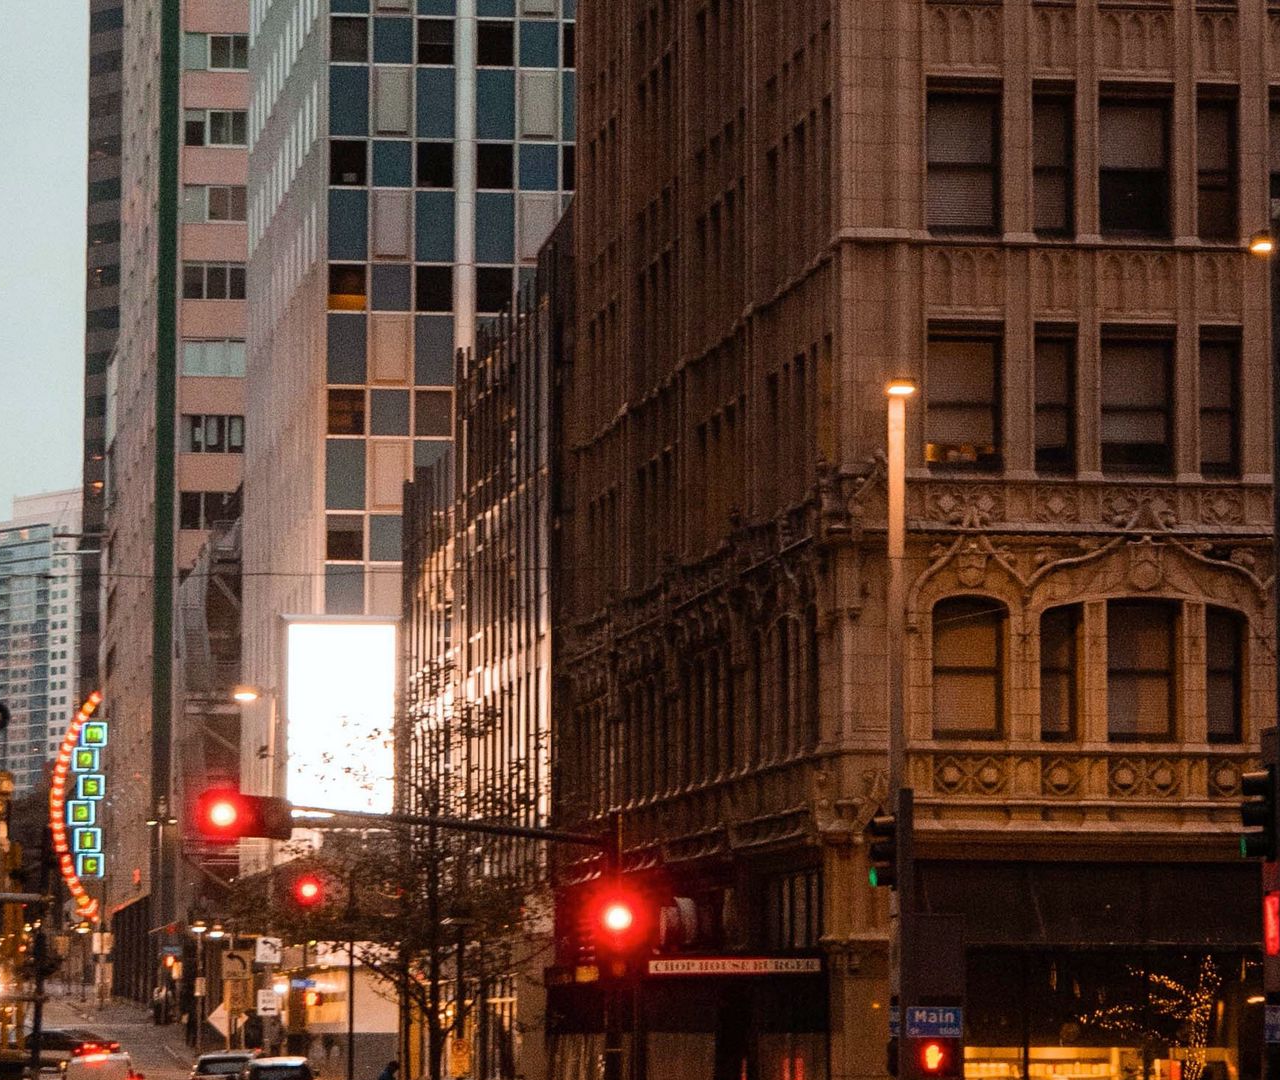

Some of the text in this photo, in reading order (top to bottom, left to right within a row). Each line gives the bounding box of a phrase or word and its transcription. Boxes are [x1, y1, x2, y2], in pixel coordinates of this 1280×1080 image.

[654, 960, 816, 972] CHOP HOUSE BURGER
[914, 1009, 955, 1023] Main
